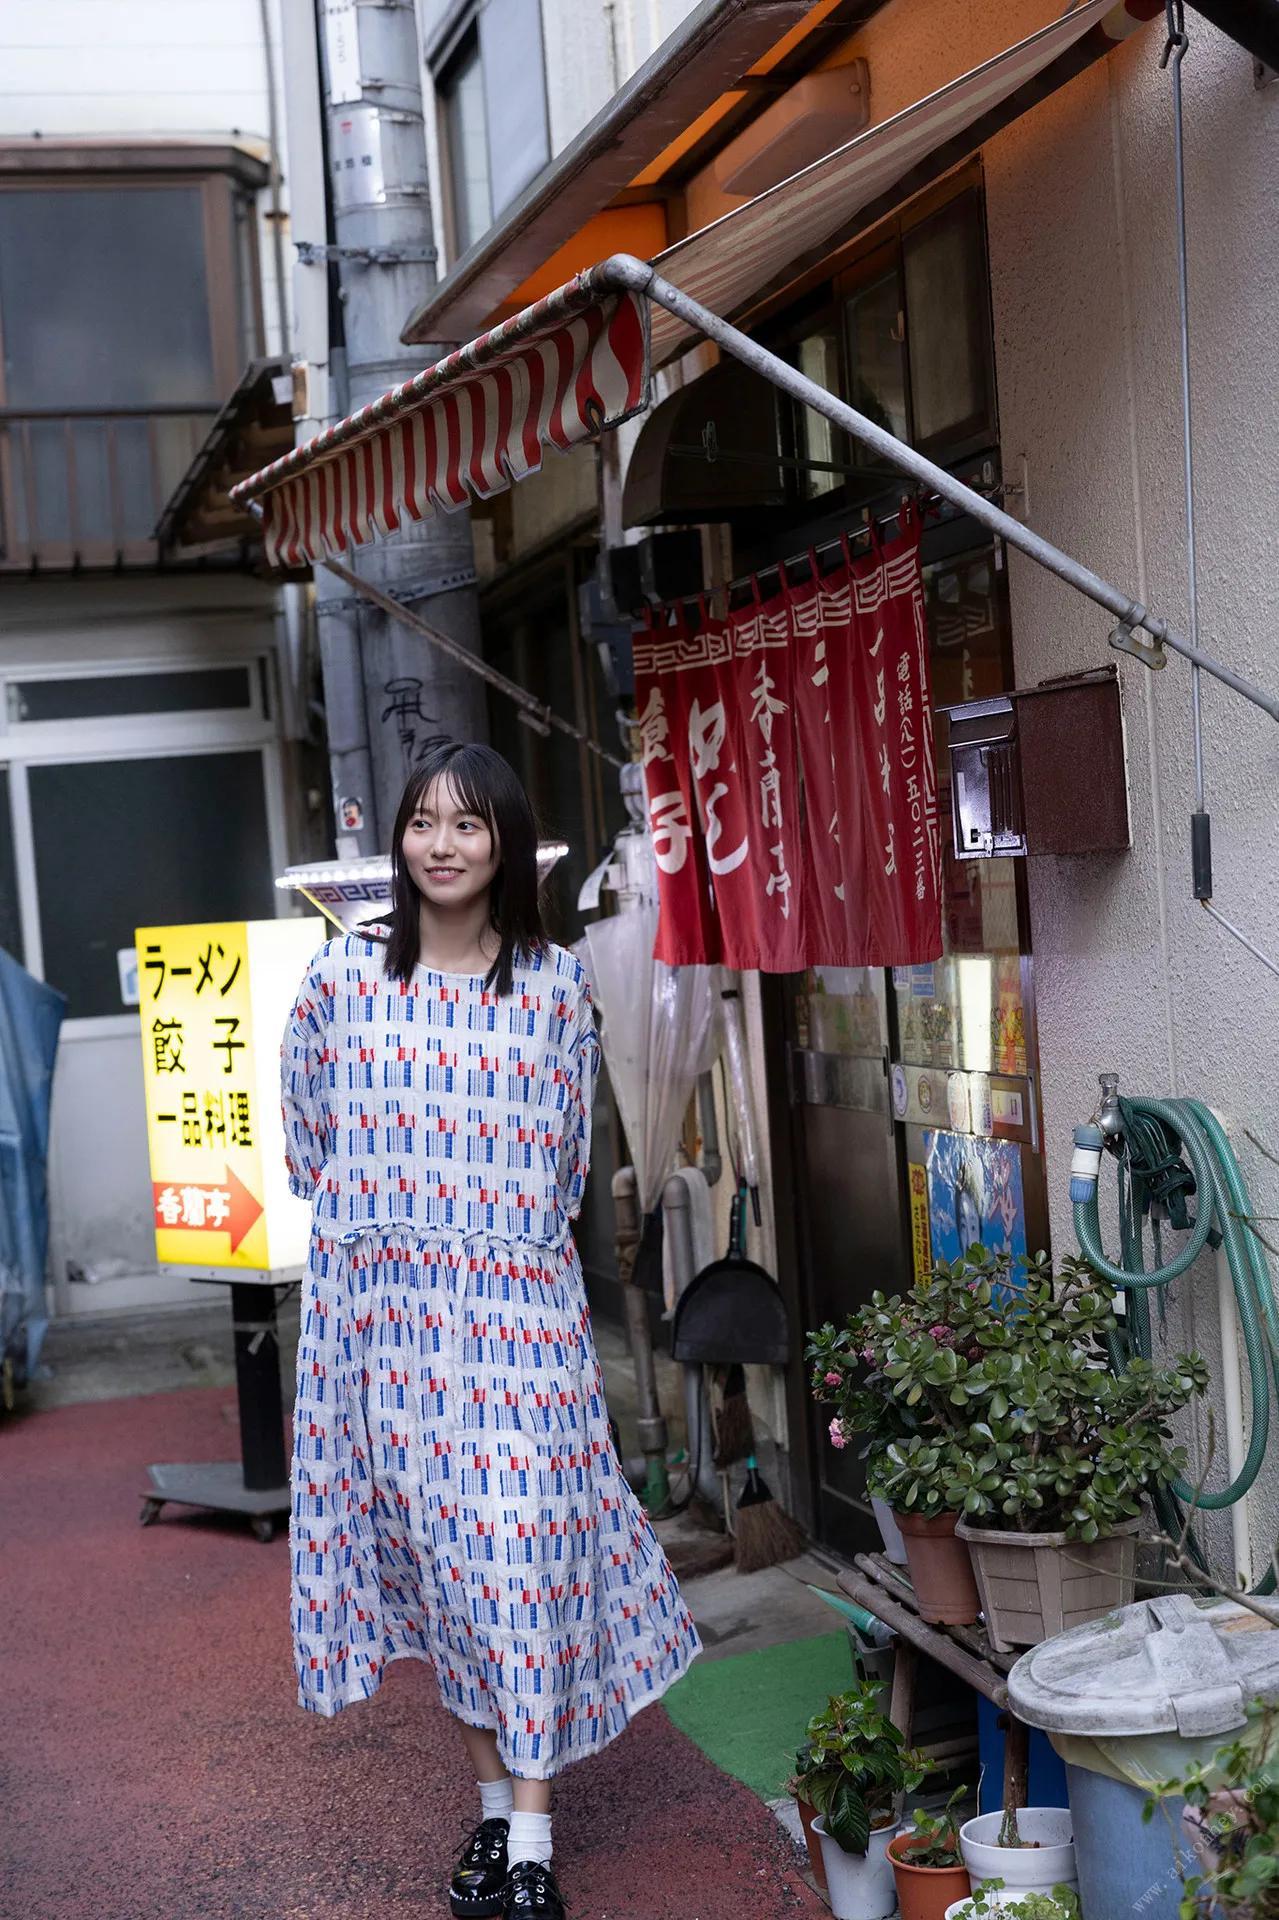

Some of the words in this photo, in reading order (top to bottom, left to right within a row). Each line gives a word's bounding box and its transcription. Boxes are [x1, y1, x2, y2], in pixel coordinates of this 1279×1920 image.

[144, 944, 242, 1000] ラーメン
[152, 1018, 245, 1074] 餃子
[157, 1091, 253, 1148] 一品料理
